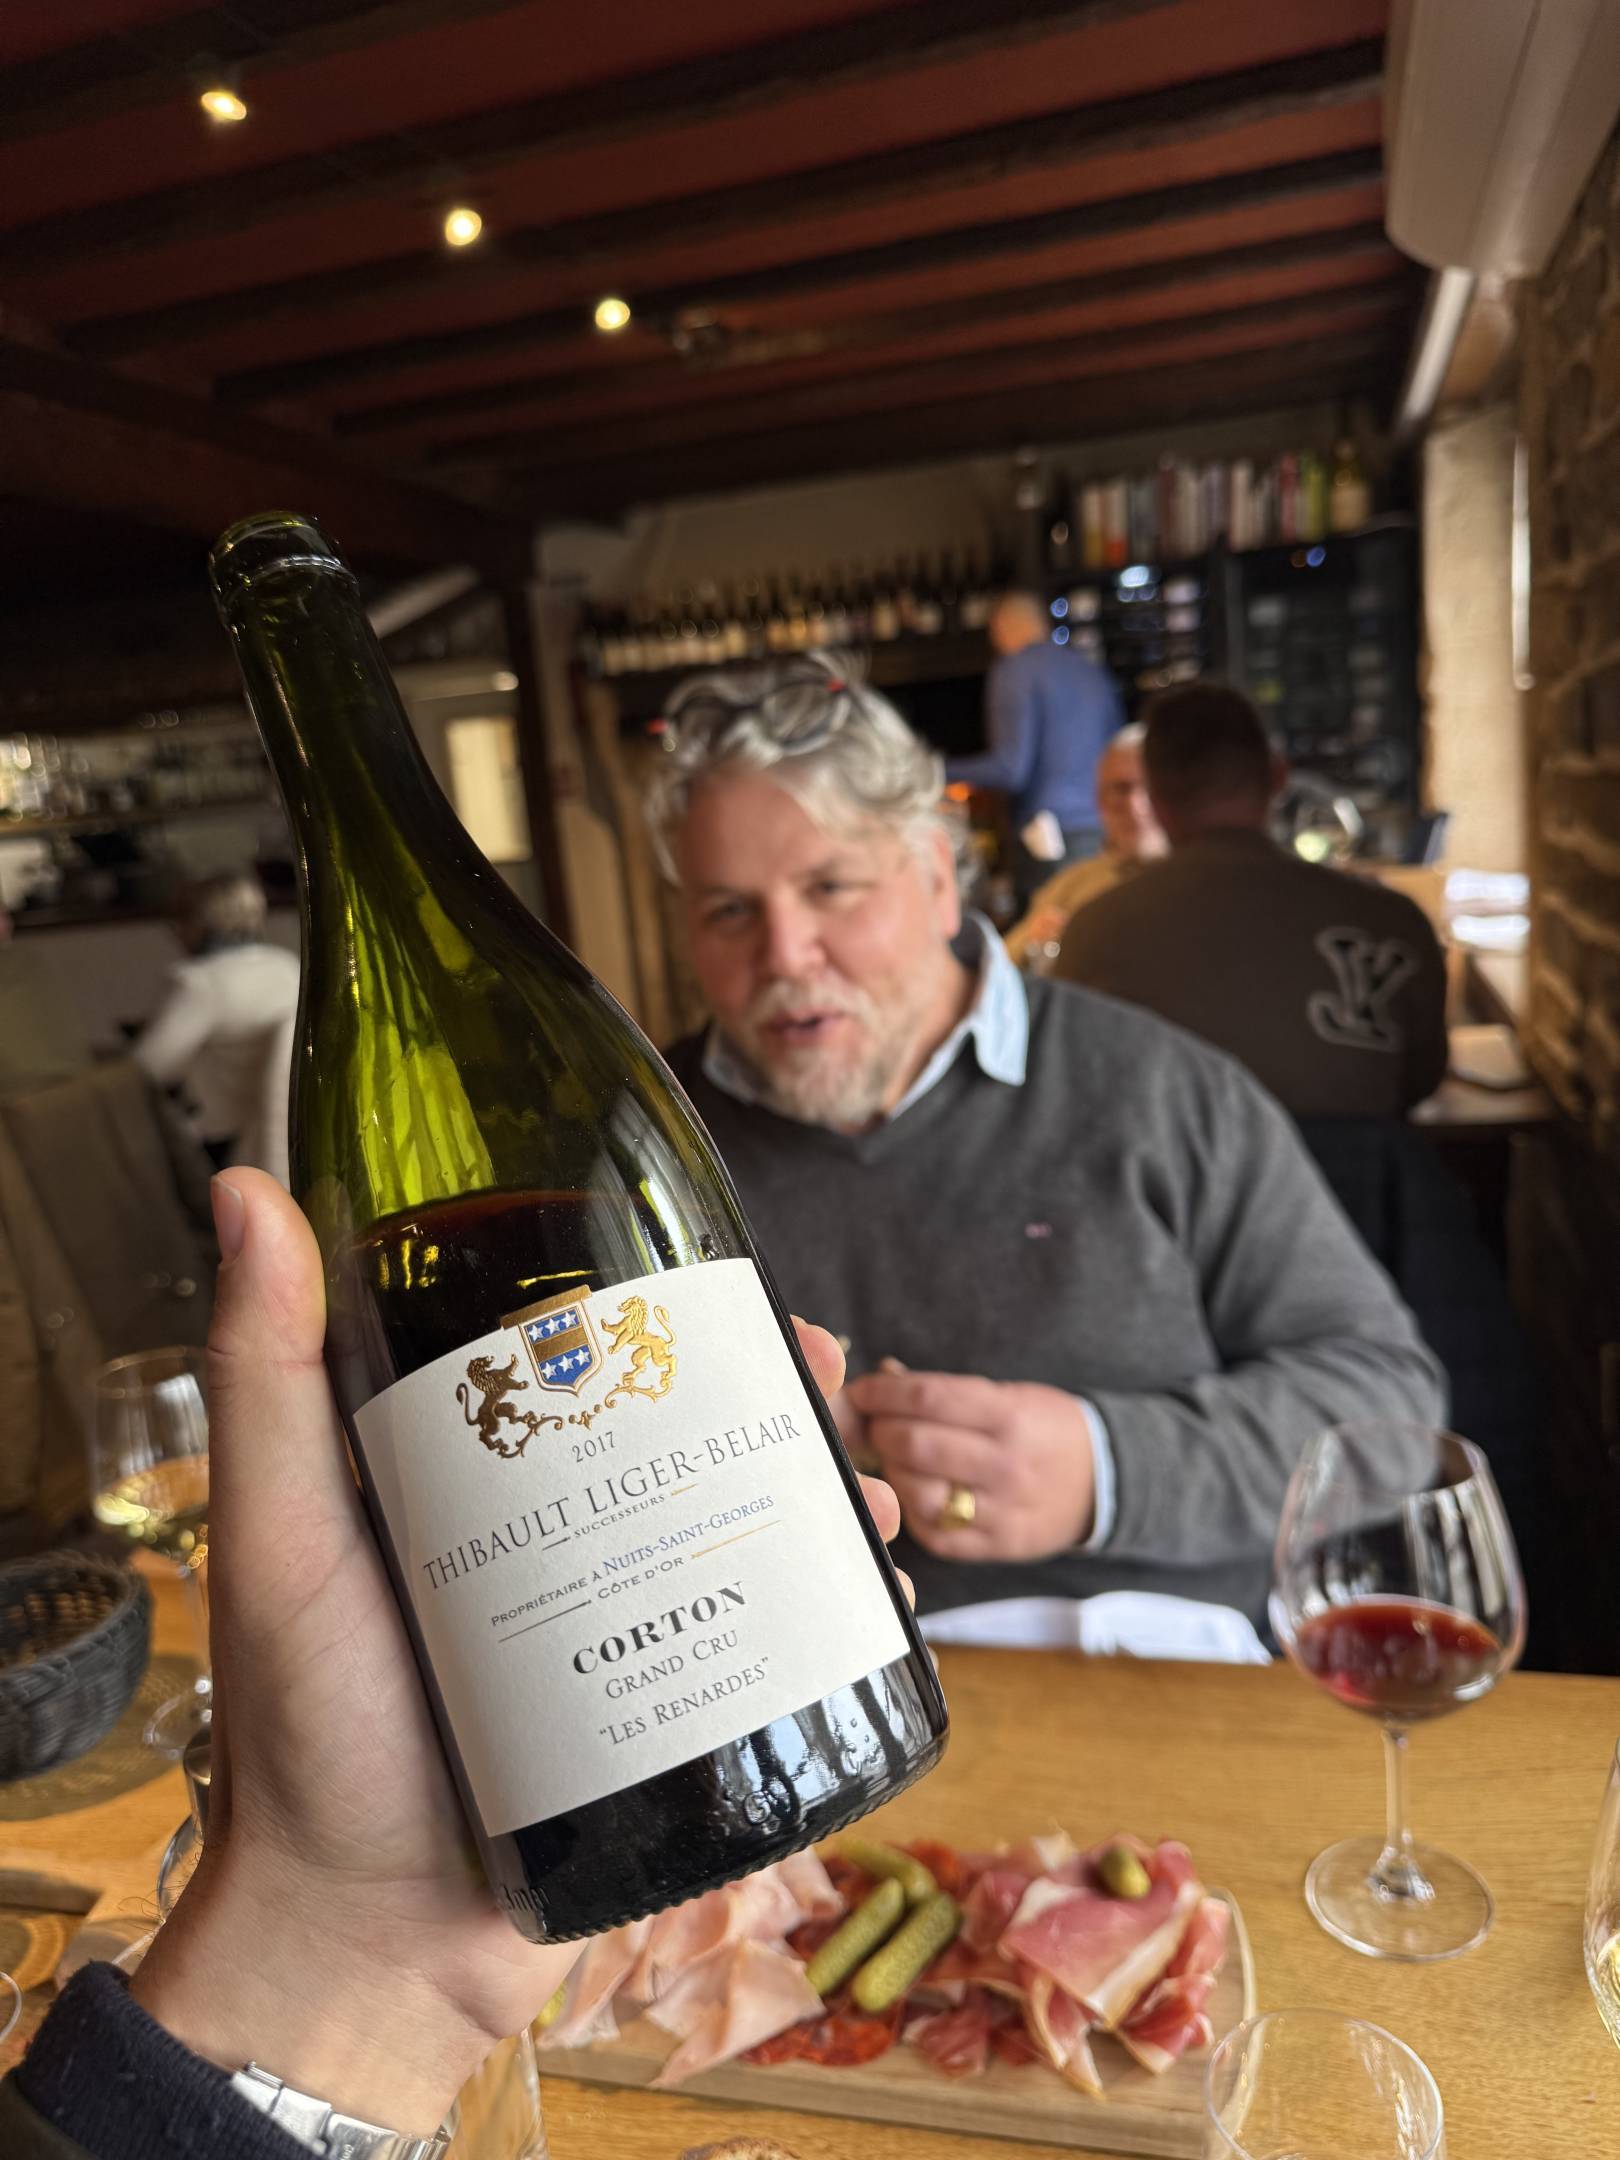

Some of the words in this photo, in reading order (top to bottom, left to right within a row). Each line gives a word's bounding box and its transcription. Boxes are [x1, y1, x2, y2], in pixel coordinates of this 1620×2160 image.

[571, 1431, 616, 1463] 2017
[423, 1497, 571, 1589] THIBAULT
[585, 1413, 801, 1514] LIGER-BELAIR
[574, 1495, 665, 1538] SUCCESSEURS
[491, 1578, 588, 1626] PROPRIÉTAIRE
[603, 1495, 775, 1575] NUITS-SAINT-GEORGES
[598, 1574, 641, 1599] CÔTE
[645, 1557, 684, 1580] D'OR
[573, 1580, 746, 1674] CORTON
[605, 1655, 684, 1698] GRAND
[693, 1630, 738, 1660] CRU
